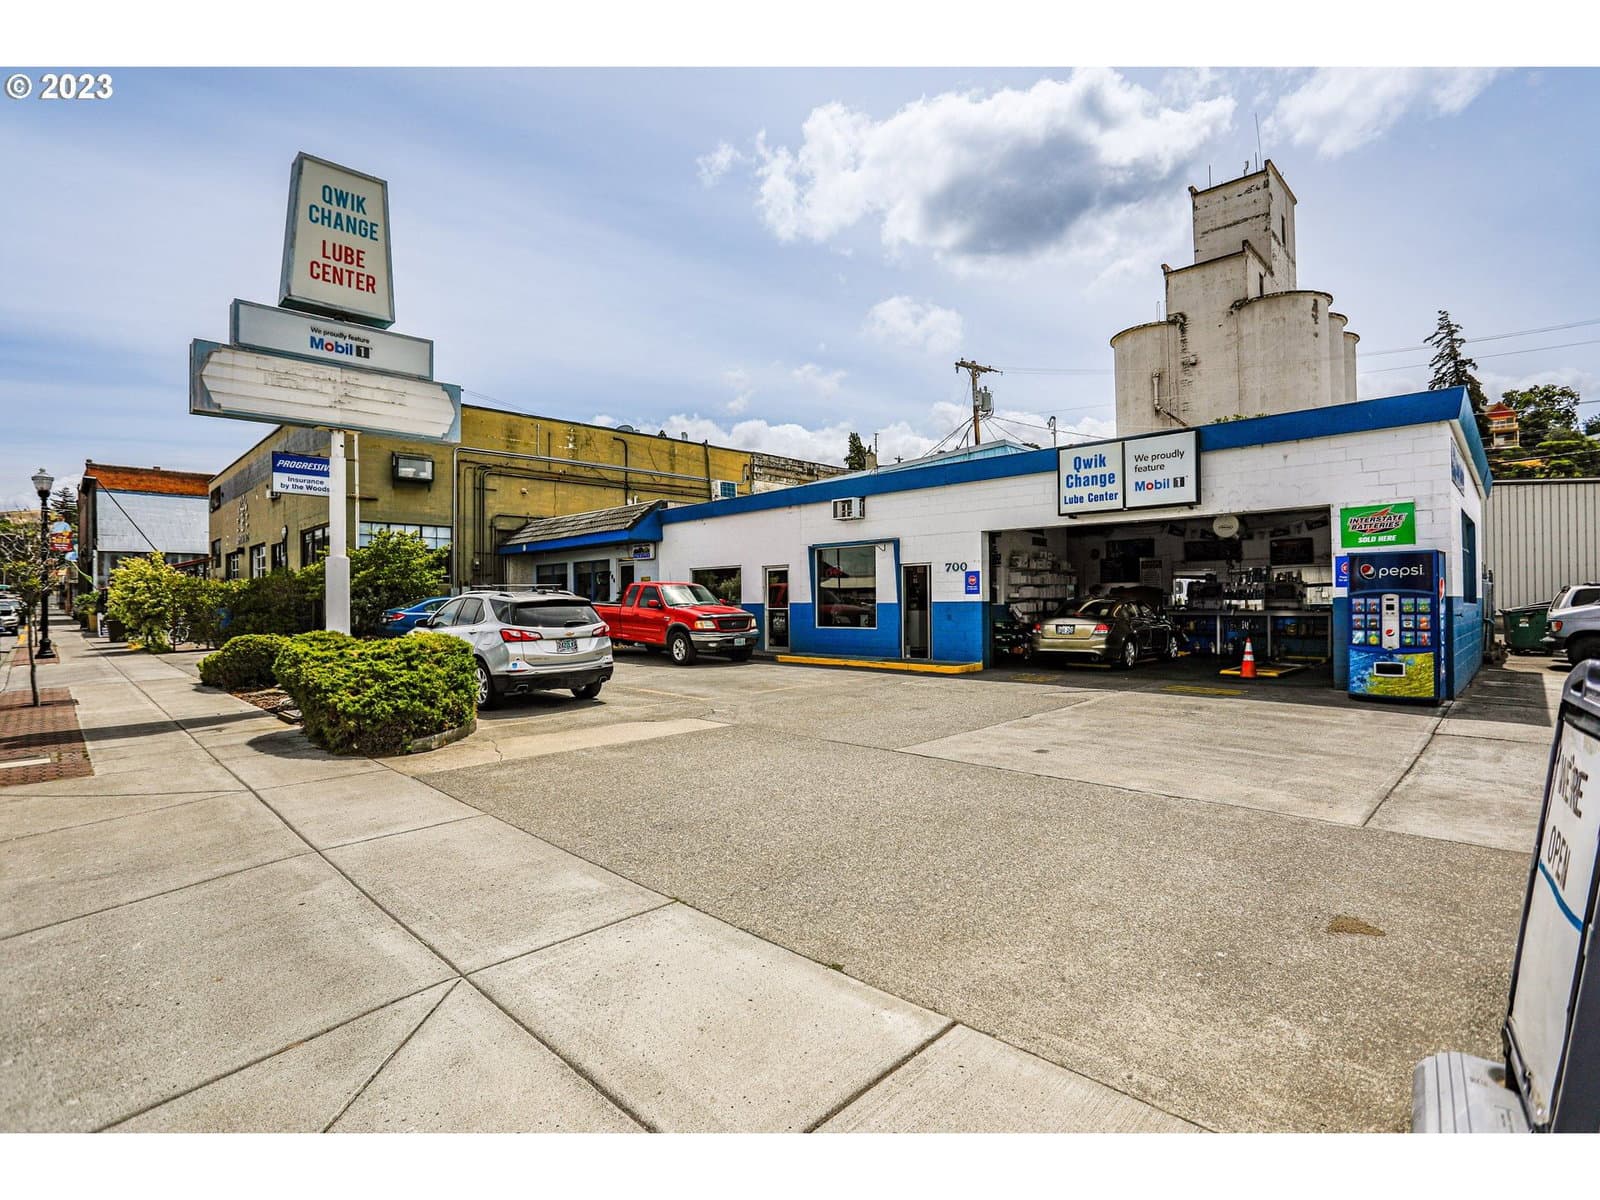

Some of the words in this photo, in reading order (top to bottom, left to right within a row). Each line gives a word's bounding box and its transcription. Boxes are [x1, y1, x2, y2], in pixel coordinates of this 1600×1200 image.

[322, 184, 367, 215] QWIK
[308, 204, 379, 241] CHANGE
[322, 240, 366, 269] LUBE
[309, 260, 376, 294] CENTER
[310, 326, 322, 334] We
[323, 330, 347, 340] proudly
[348, 334, 370, 344] feature
[310, 335, 353, 356] Mobil
[1073, 453, 1107, 473] Qwik
[1134, 454, 1149, 463] We
[1151, 449, 1185, 463] proudly
[276, 459, 330, 472] PROGRESSIV
[1134, 464, 1165, 473] feature
[280, 482, 289, 490] by
[287, 476, 325, 485] Insurance
[1065, 472, 1116, 489] Change
[1134, 478, 1170, 492] Mobil
[1173, 477, 1185, 488] 1
[1063, 494, 1084, 505] Lube
[1087, 491, 1119, 503] Center
[1349, 514, 1404, 525] INTERSTATE
[1351, 521, 1400, 531] BATTERIES
[1358, 536, 1376, 544] SOLD
[1378, 535, 1397, 543] HERE
[945, 562, 968, 572] 700
[1378, 564, 1424, 579] pepsi
[1547, 825, 1571, 891] OPEN
